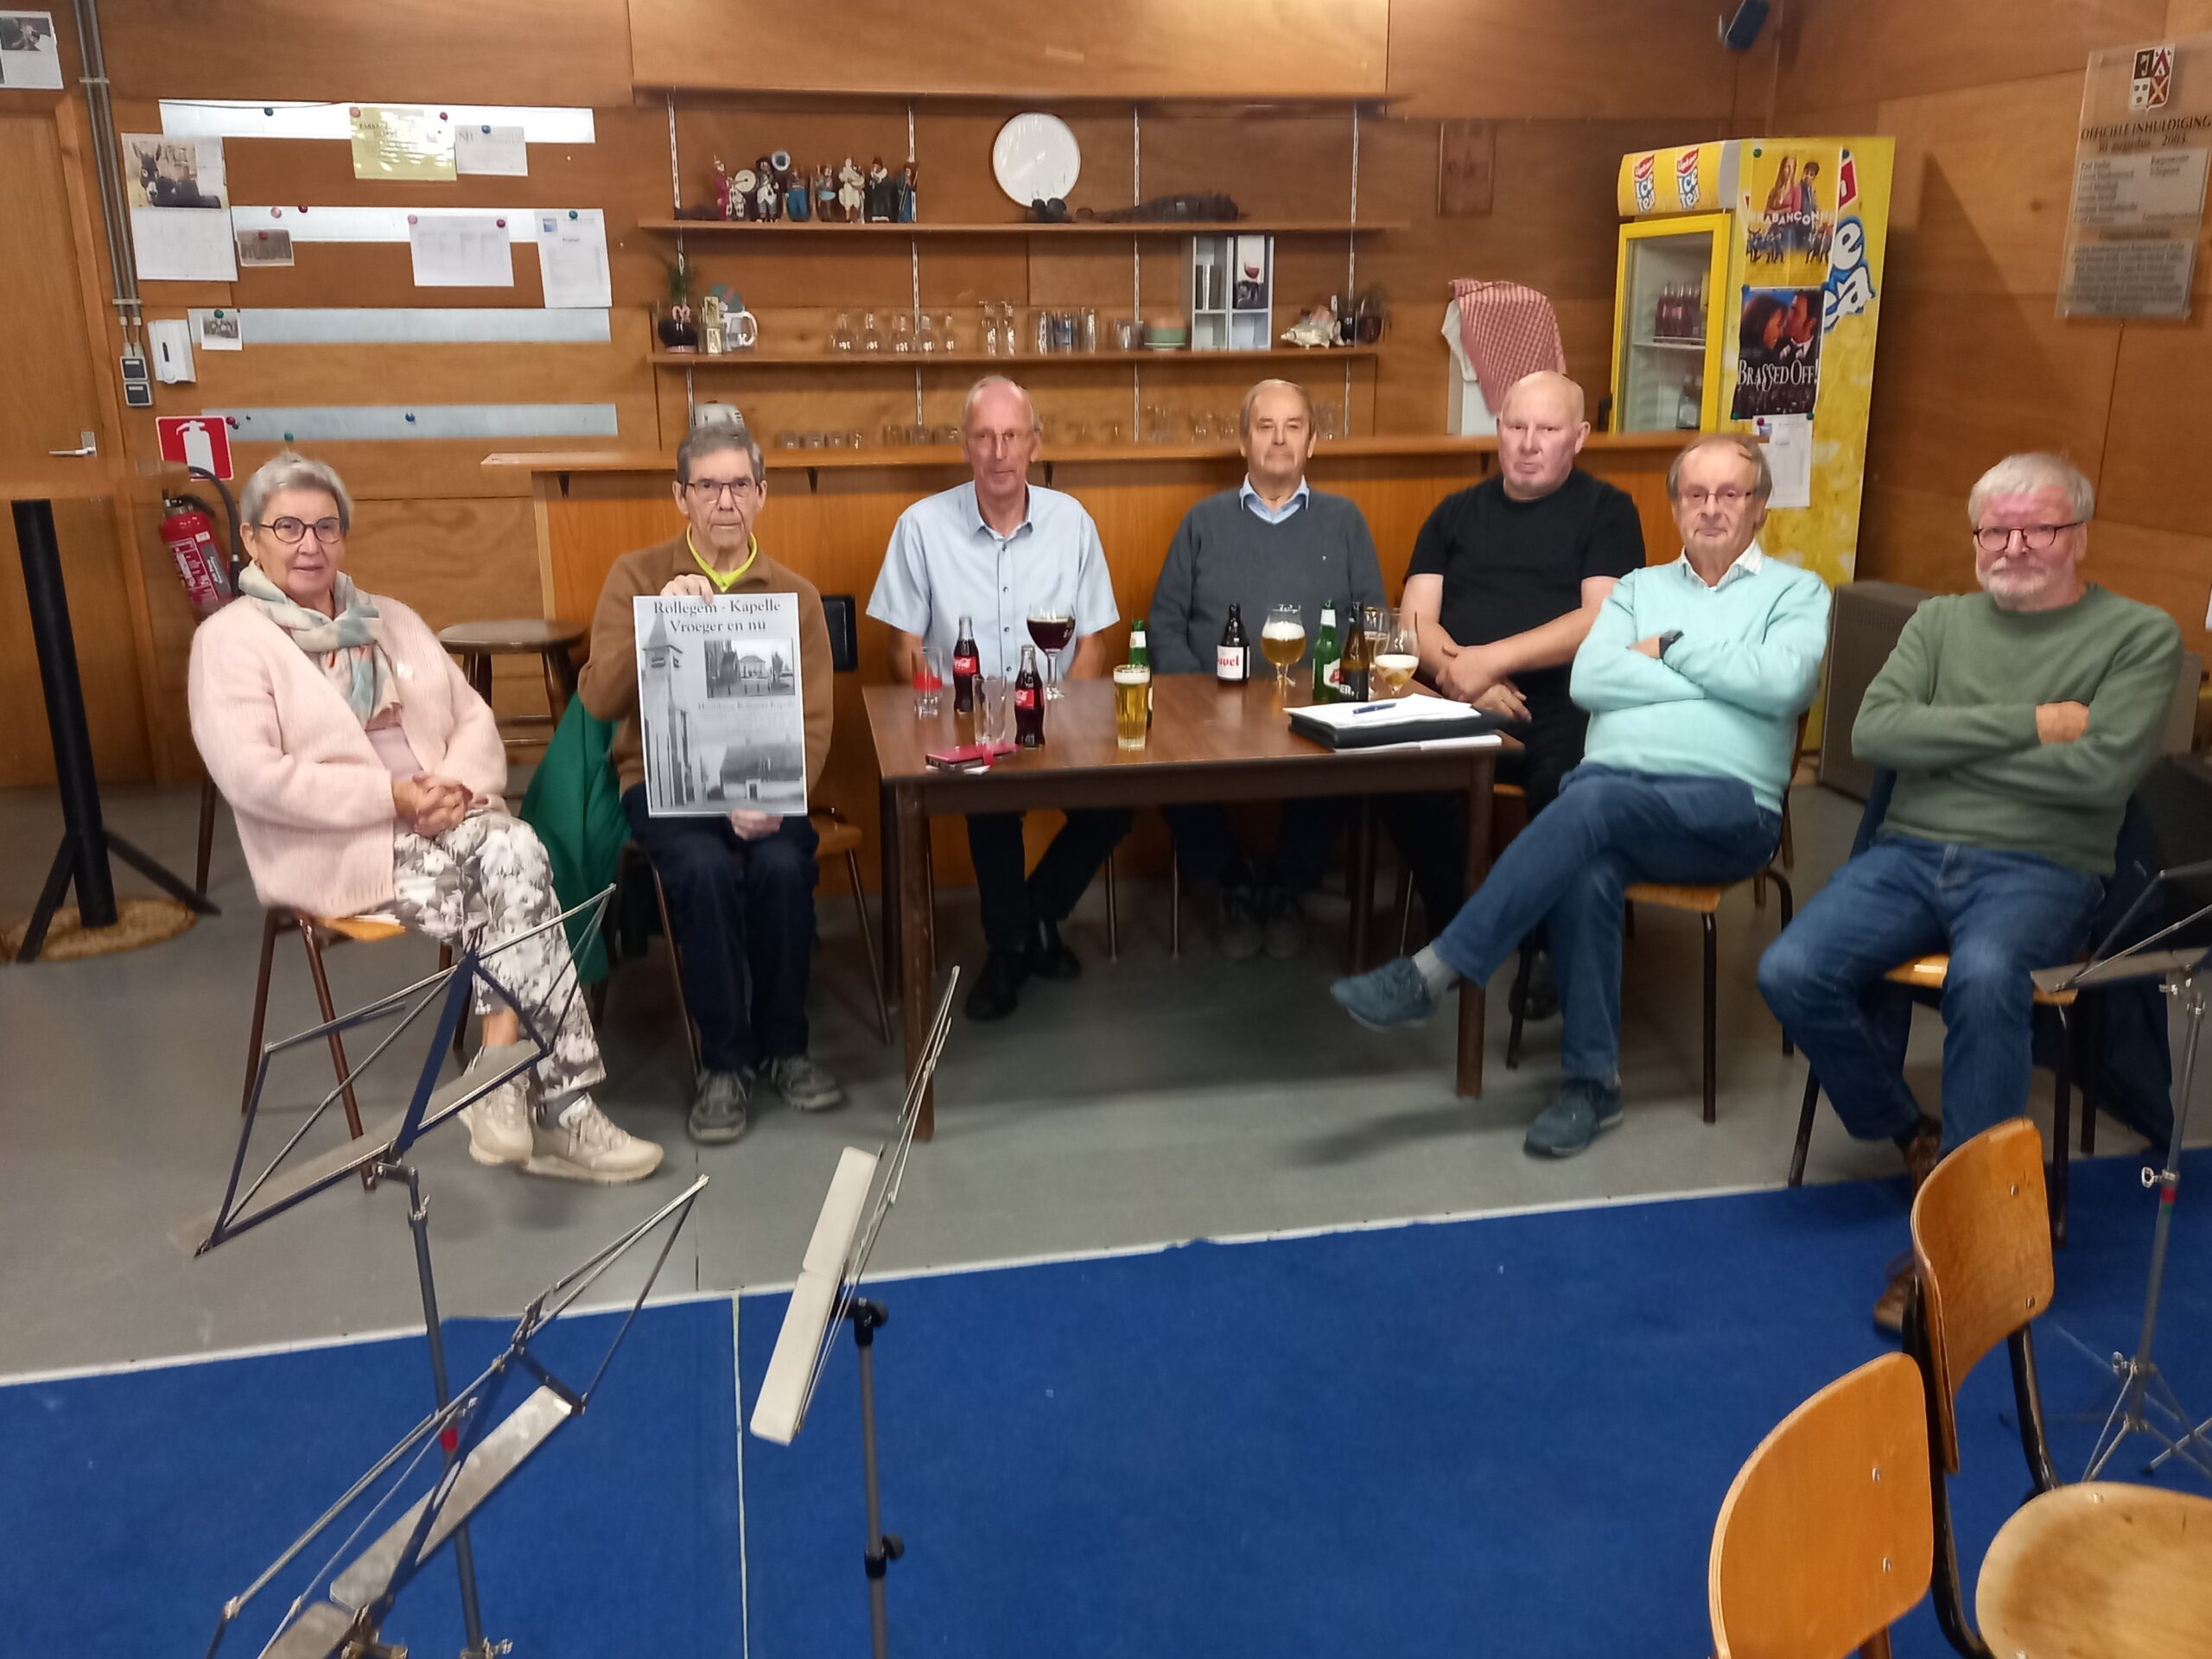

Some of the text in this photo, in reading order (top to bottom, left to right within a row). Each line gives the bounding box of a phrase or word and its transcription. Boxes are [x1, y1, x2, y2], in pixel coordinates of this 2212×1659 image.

[654, 599, 717, 615] Rollegem
[730, 598, 780, 614] Kapelle
[670, 620, 766, 633] Vroeger en nu
